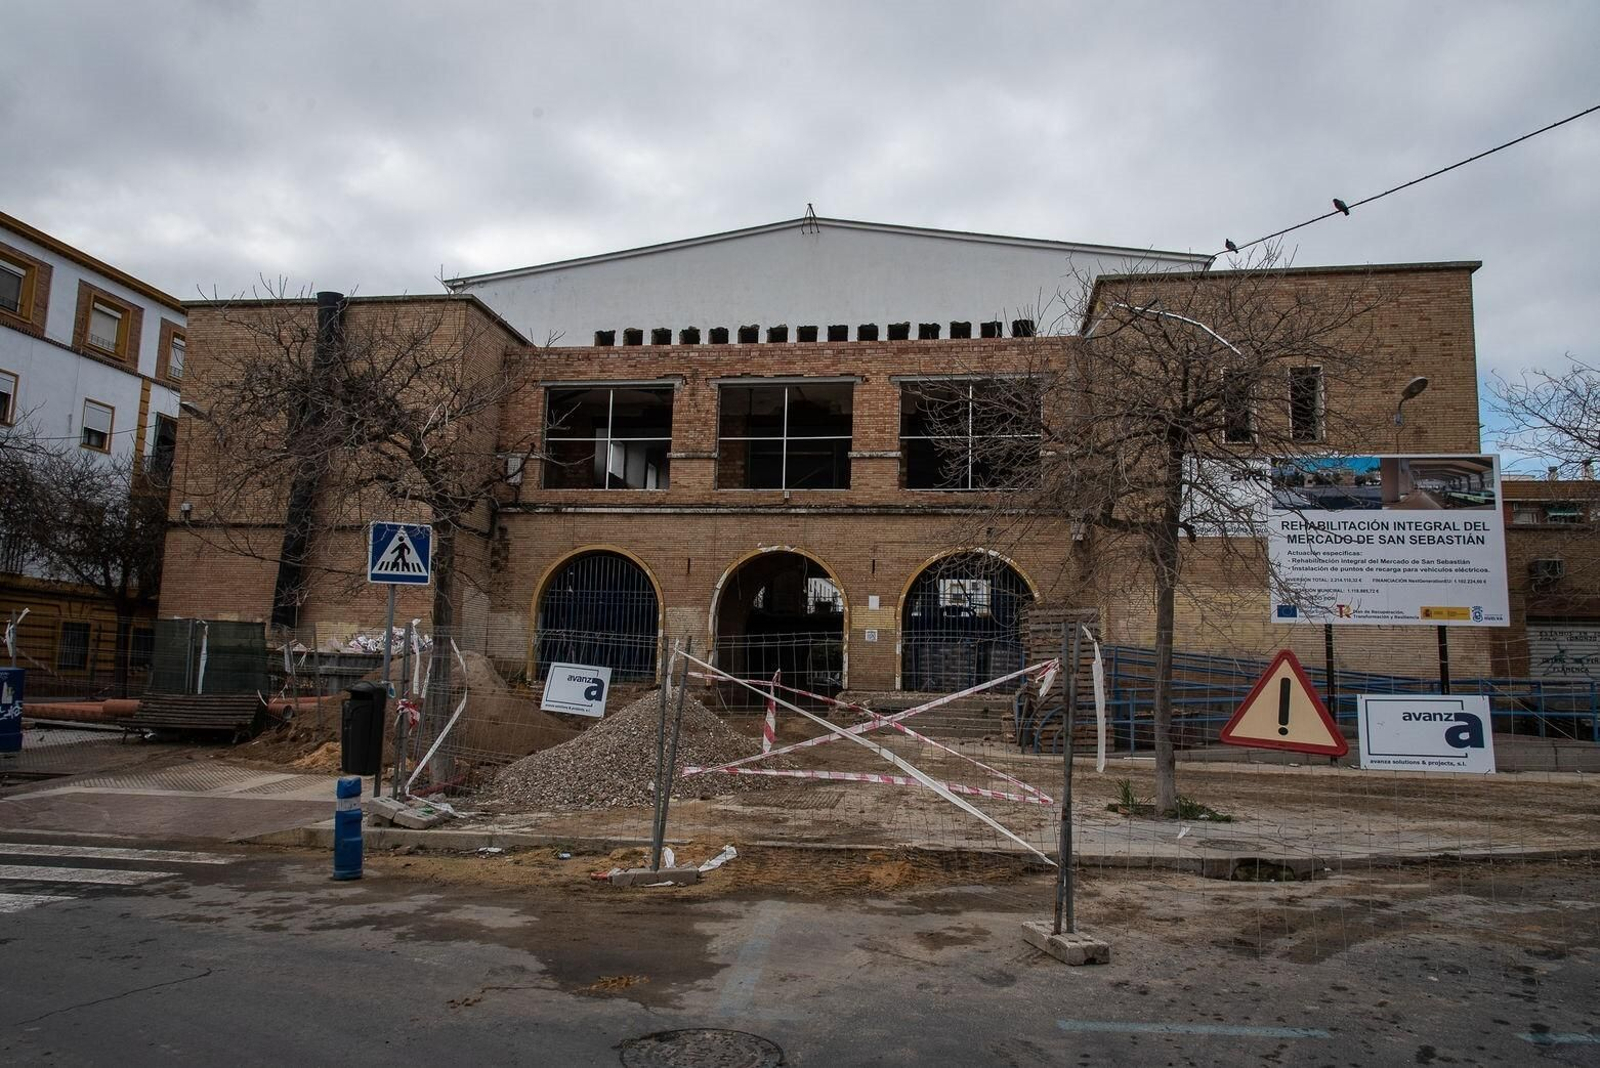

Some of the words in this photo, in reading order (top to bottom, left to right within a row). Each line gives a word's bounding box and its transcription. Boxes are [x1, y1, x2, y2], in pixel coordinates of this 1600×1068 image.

[1281, 519, 1389, 531] REHABILITACIÓN
[1394, 521, 1460, 532] INTEGRAL
[1464, 521, 1490, 532] DEL
[1287, 534, 1353, 545] MERCADO
[1357, 534, 1375, 545] DE
[1378, 534, 1405, 545] SAN
[1409, 533, 1485, 546] SEBASTIÁN
[1340, 566, 1364, 574] puntos
[1376, 567, 1401, 575] recarga
[1402, 711, 1484, 748] avanza
